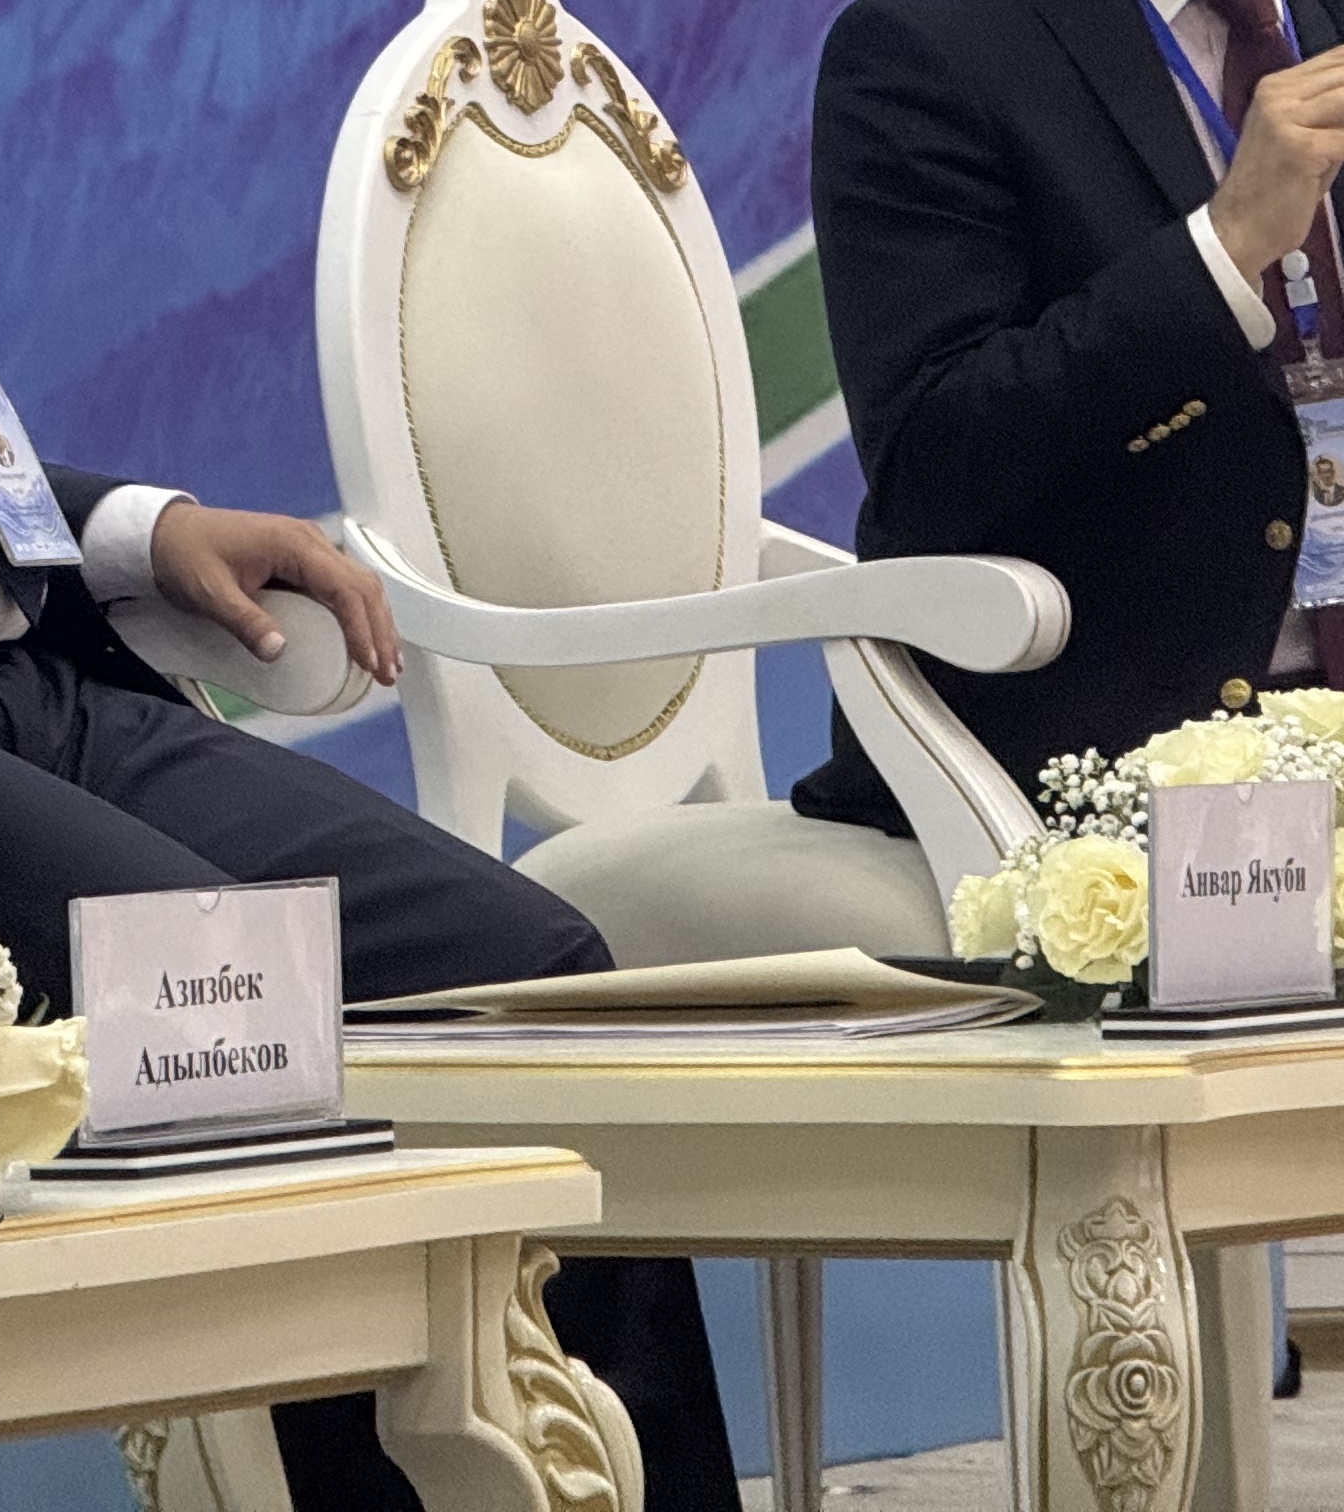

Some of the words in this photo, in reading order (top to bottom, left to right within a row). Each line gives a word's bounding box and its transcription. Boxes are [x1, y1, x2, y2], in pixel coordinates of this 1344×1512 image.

[1181, 863, 1243, 906] Анвар
[1247, 857, 1306, 903] Якуби
[154, 964, 264, 1010] Азизбек
[134, 1038, 289, 1087] Адылбеков
